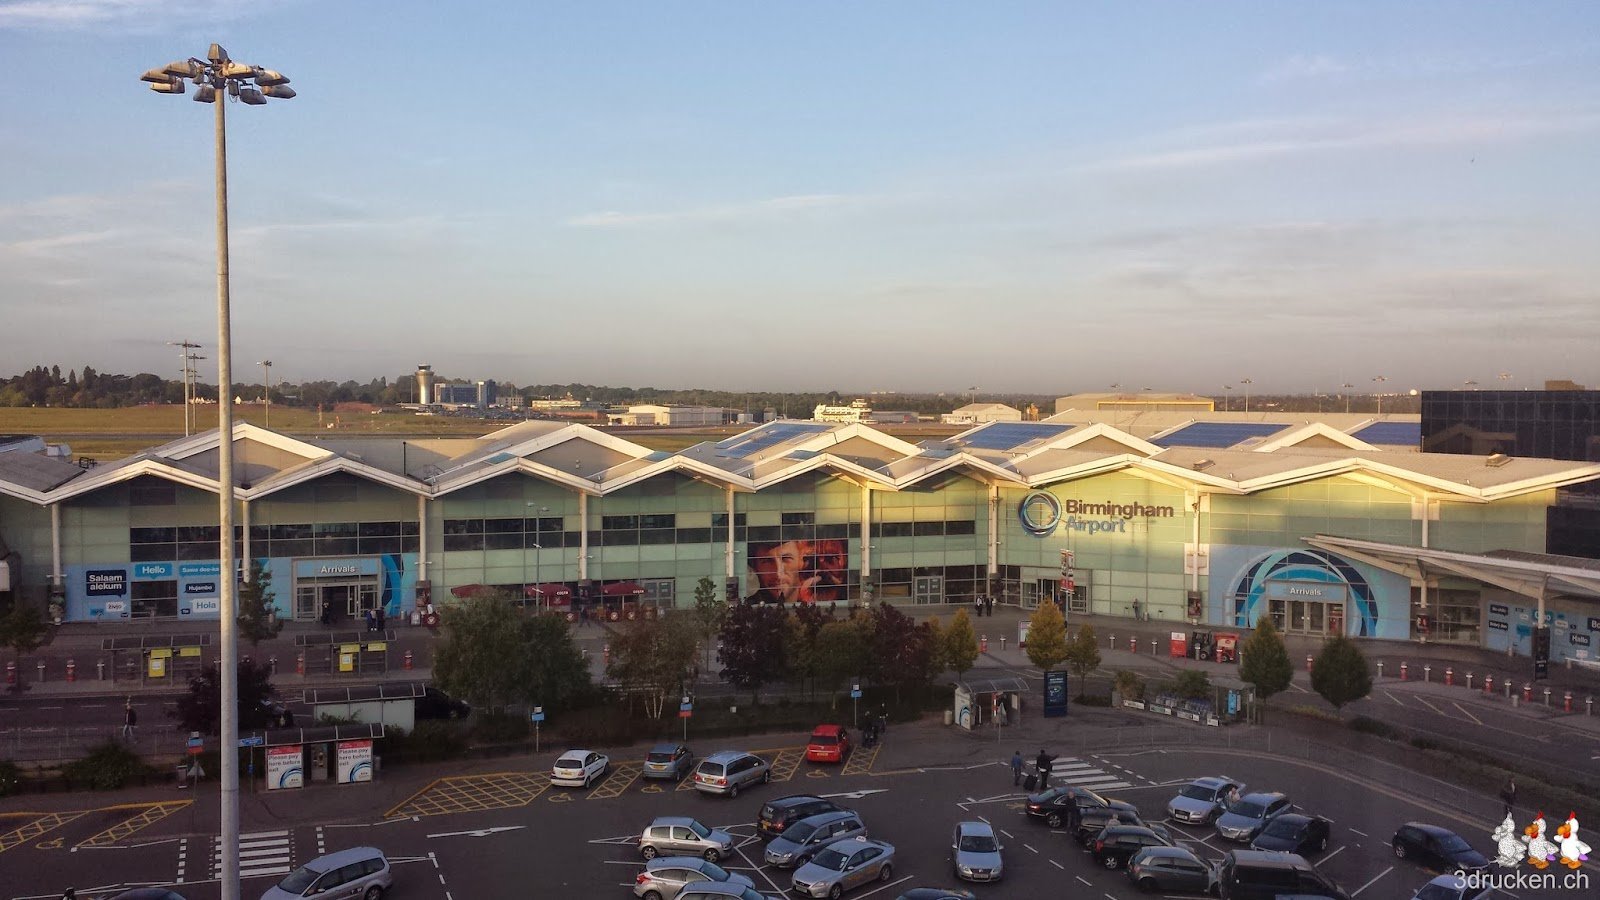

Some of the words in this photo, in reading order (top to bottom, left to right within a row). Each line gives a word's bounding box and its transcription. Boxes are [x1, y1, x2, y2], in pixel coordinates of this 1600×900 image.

[1066, 499, 1174, 519] Birmingham
[1065, 515, 1126, 535] Airport
[142, 565, 166, 574] Hello
[320, 565, 356, 574] Arrivals
[89, 574, 123, 582] Salaam
[90, 582, 122, 591] alekum
[1290, 587, 1322, 596] Arrivals
[196, 601, 217, 609] Hola
[1571, 635, 1589, 644] Hallo
